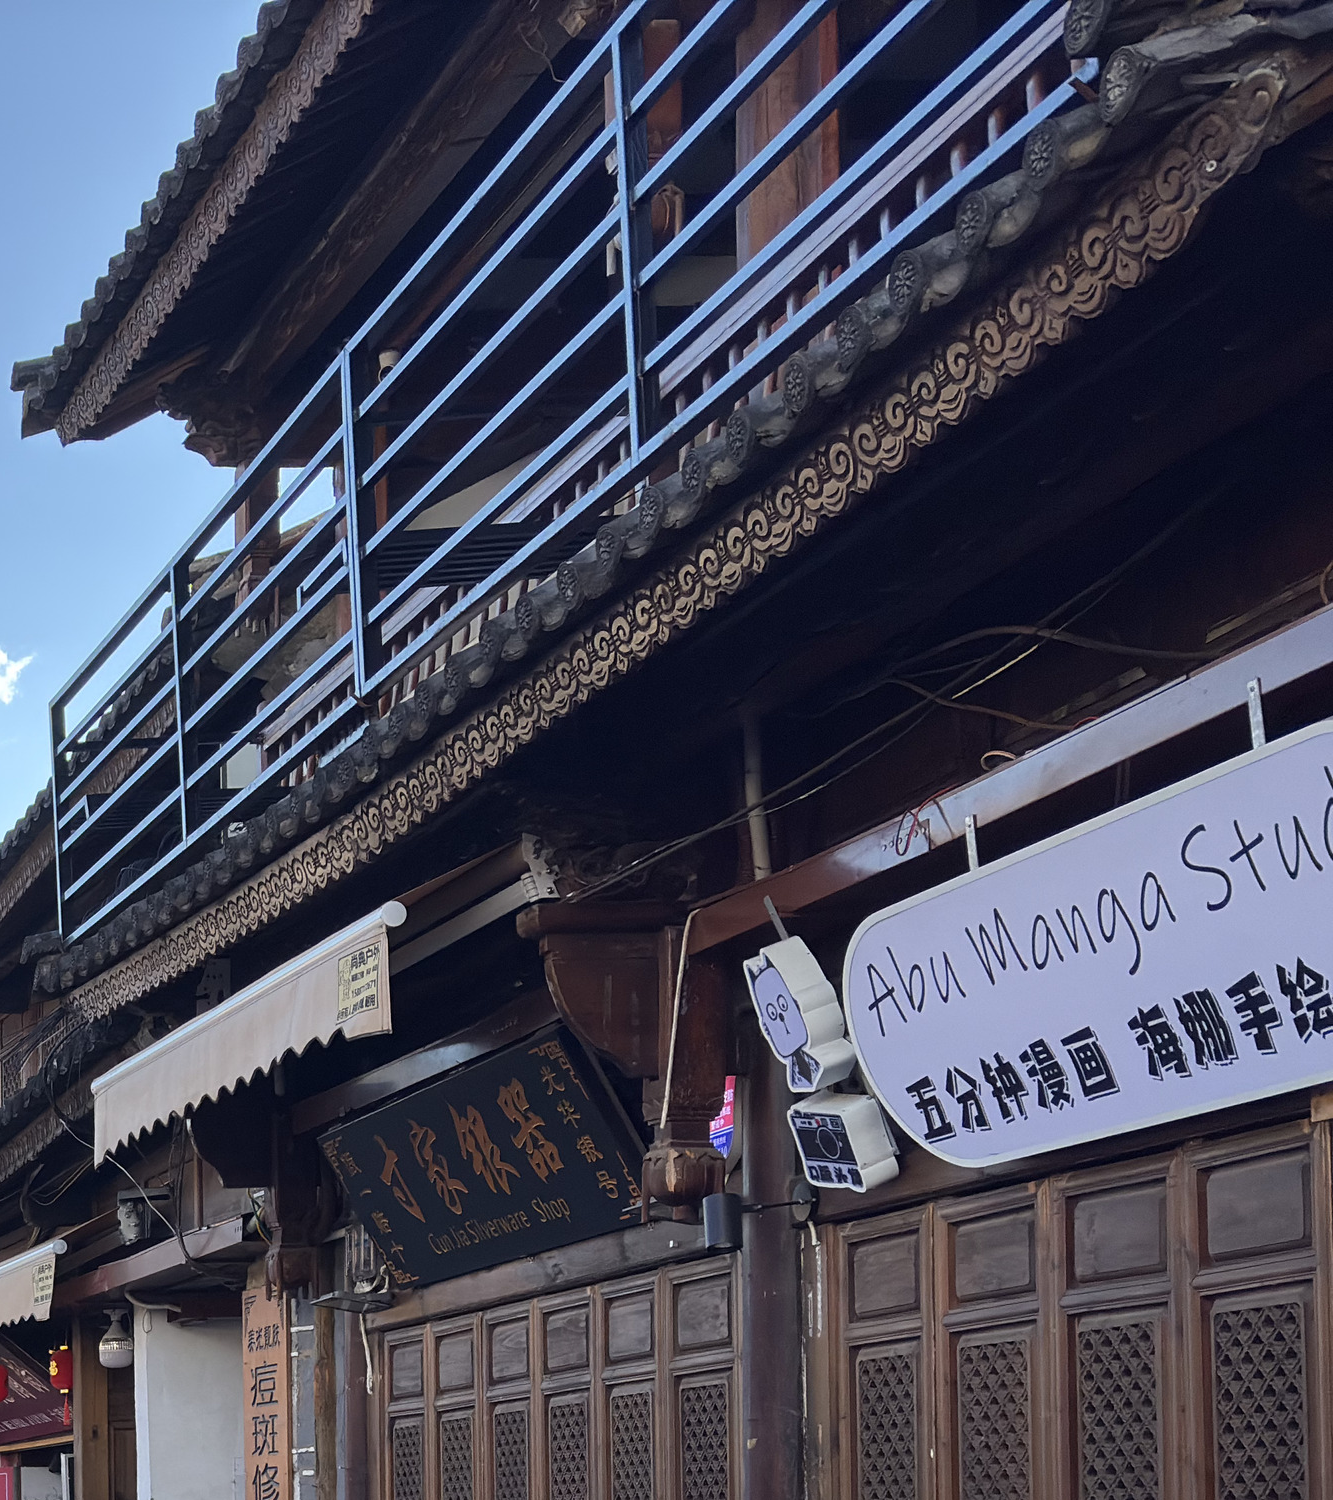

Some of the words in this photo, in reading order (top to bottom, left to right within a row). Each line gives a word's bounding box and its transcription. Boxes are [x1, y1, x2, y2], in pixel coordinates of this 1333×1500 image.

[866, 945, 967, 1037] Abu
[964, 870, 1177, 976] Manga
[904, 1025, 1121, 1145] 五分钟漫画
[1128, 956, 1333, 1081] 海娜手绘
[531, 1194, 571, 1224] Shop
